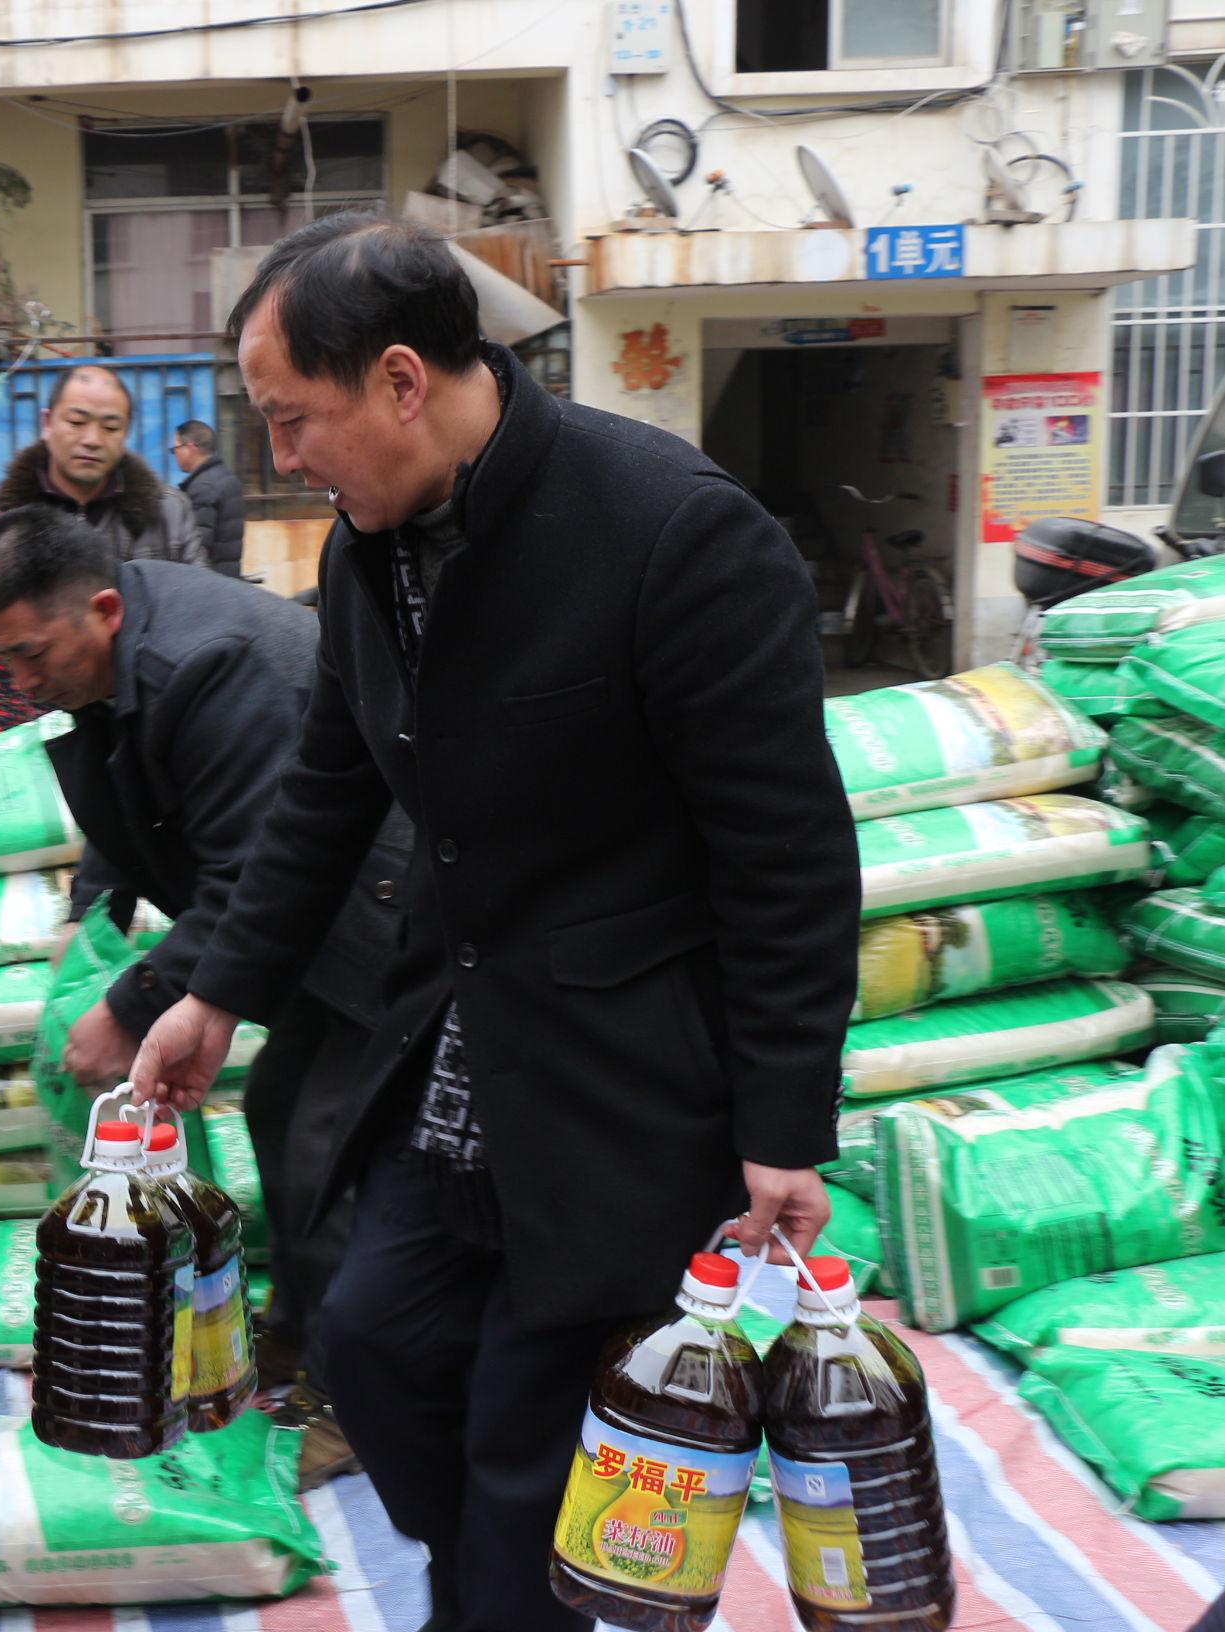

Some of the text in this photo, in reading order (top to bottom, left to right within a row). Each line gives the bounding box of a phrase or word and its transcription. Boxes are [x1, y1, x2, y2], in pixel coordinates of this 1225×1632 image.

[868, 230, 961, 275] 1单元
[592, 1442, 709, 1504] 罗福平
[602, 1517, 677, 1555] 菜籽油
